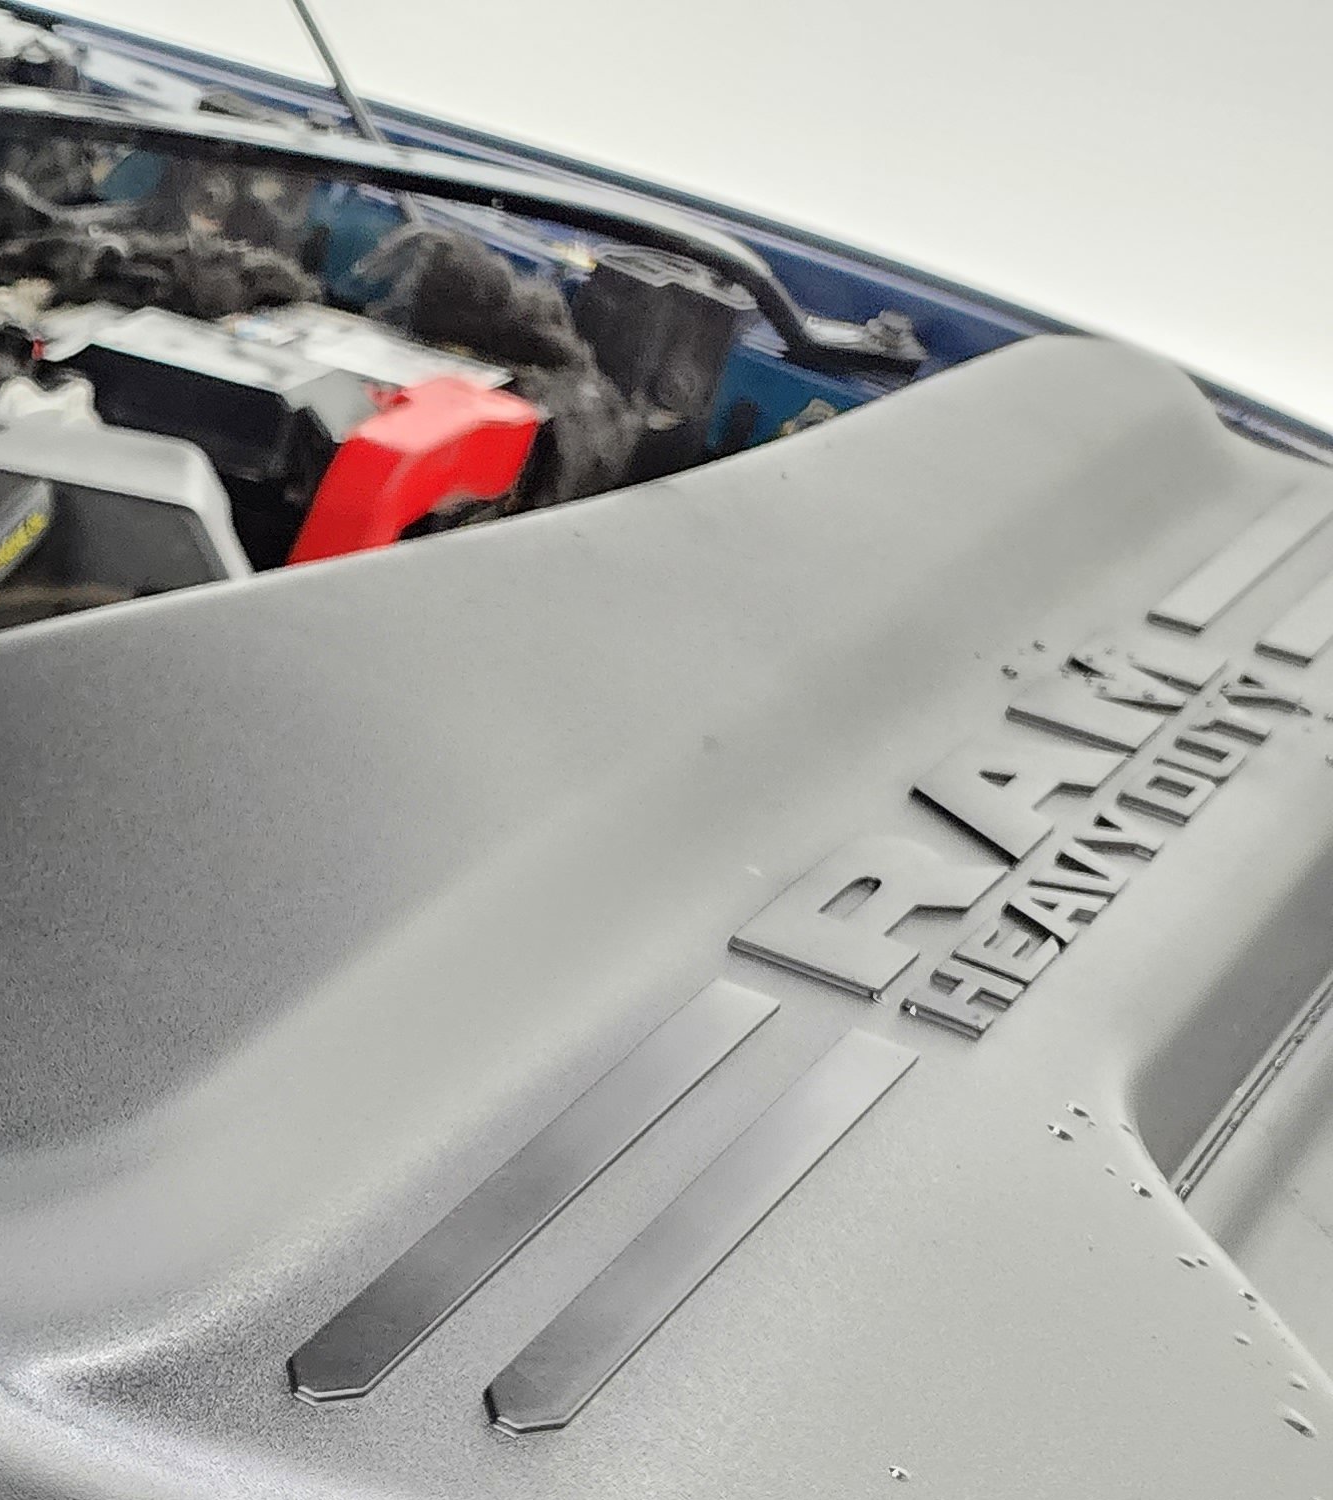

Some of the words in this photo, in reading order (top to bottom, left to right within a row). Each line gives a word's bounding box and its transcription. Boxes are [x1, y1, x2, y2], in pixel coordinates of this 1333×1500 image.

[728, 630, 1230, 1004] RAM
[899, 808, 1166, 1040] HEAVY
[1115, 668, 1312, 826] DUTY
